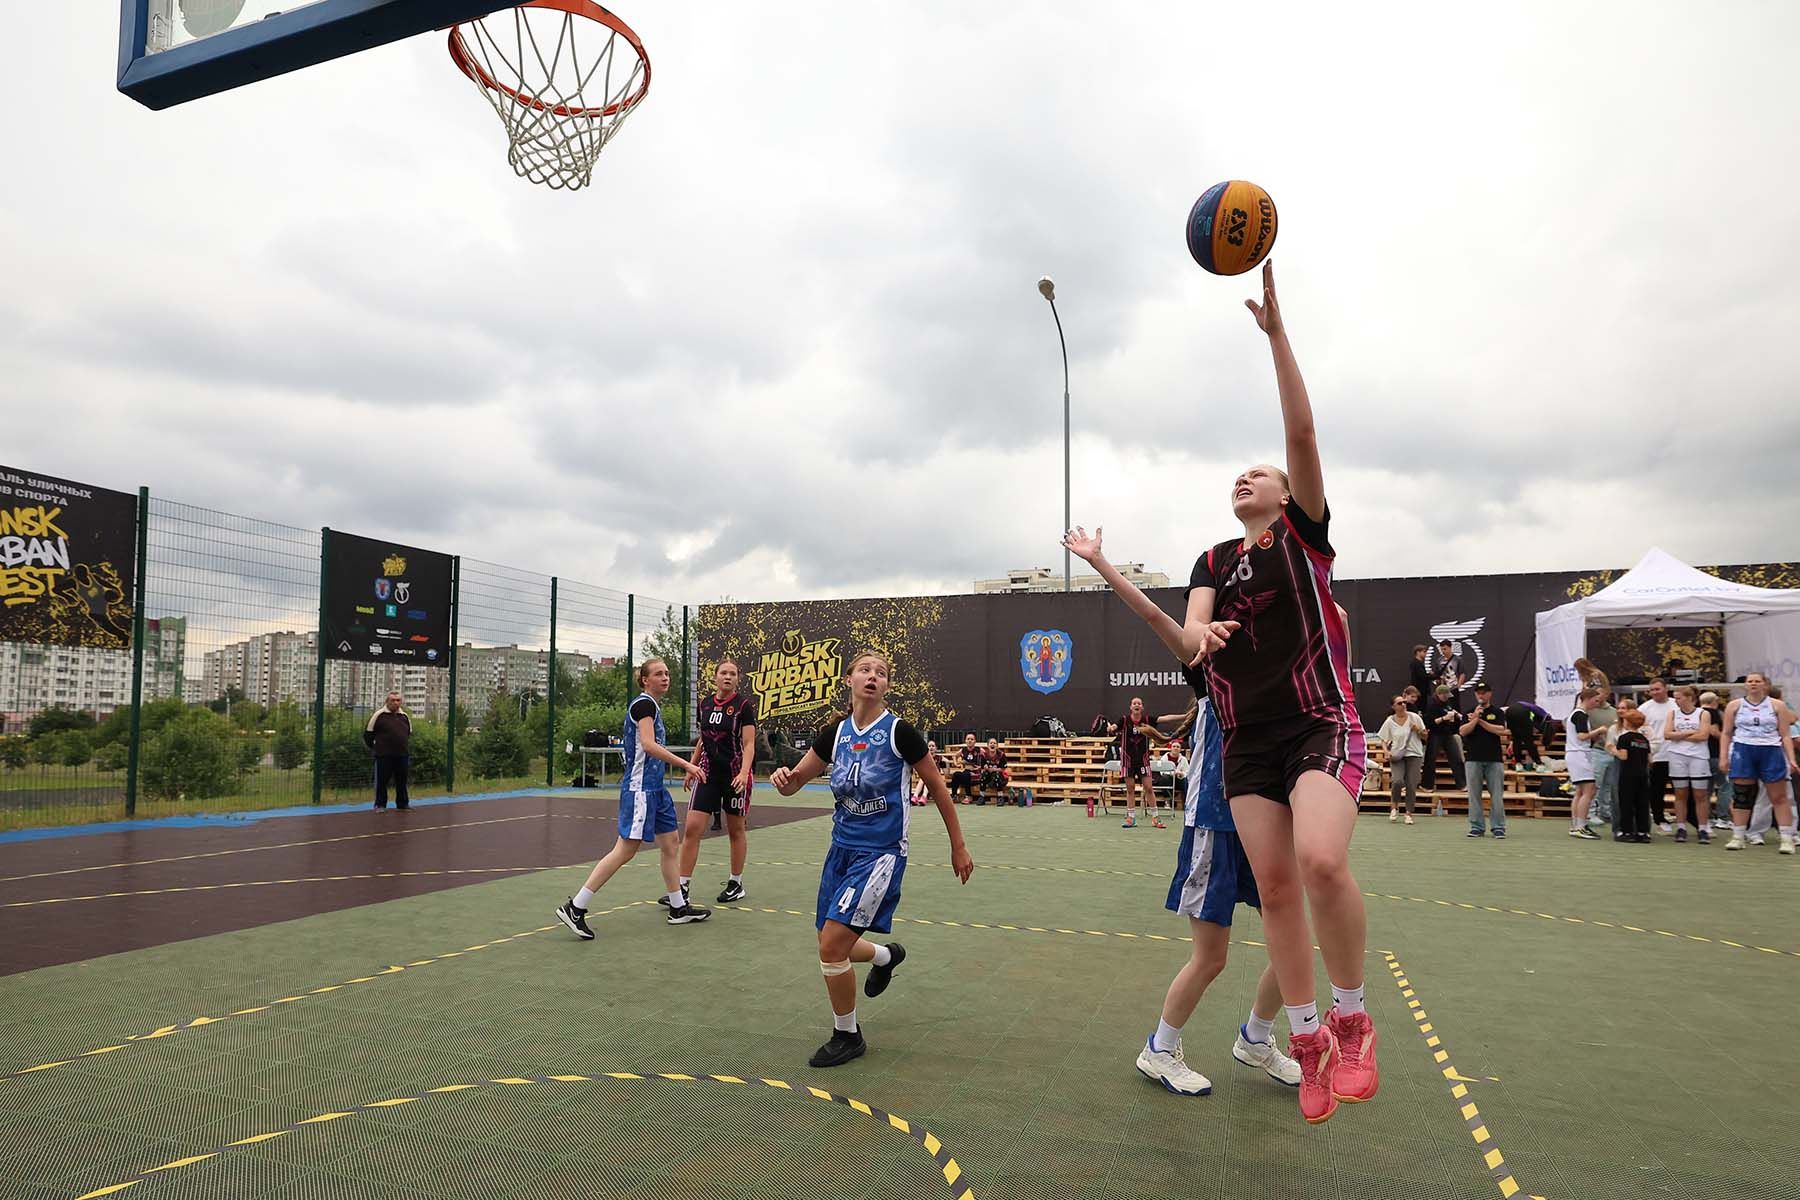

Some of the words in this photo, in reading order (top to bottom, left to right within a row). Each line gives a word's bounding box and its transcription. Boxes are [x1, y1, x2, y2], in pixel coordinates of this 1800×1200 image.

[15, 488, 68, 506] СПОРТА
[27, 478, 92, 499] УЛИЧНЫХ
[0, 505, 69, 541] NSK
[0, 565, 65, 597] EST
[761, 641, 832, 672] MINSK
[755, 658, 836, 692] URBAN
[763, 678, 829, 714] FEST
[709, 711, 723, 725] 00
[847, 761, 861, 787] 4
[731, 797, 744, 809] 00
[838, 886, 856, 914] 4
